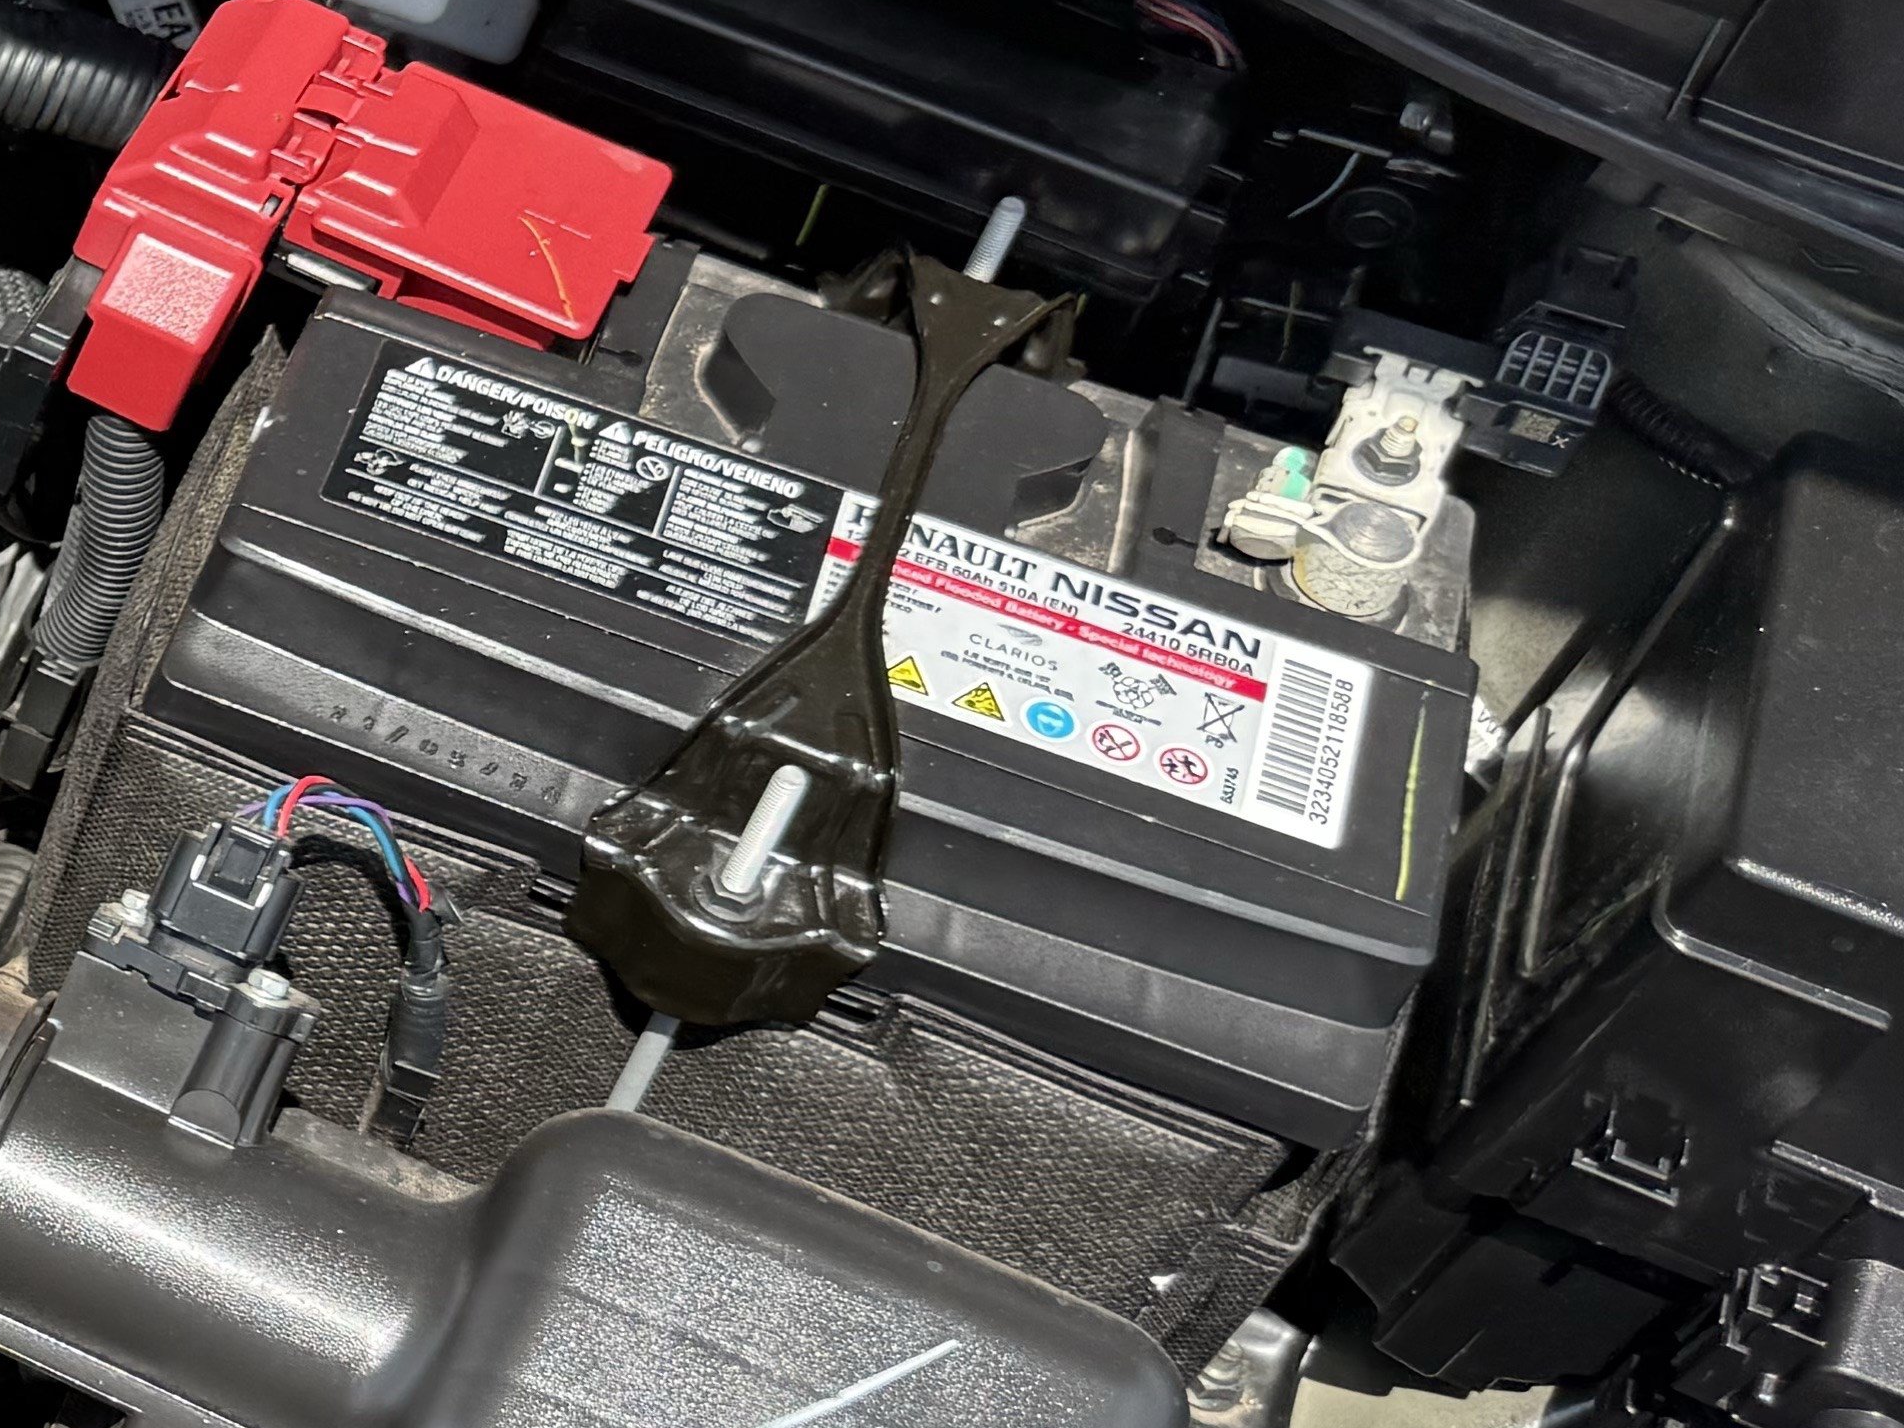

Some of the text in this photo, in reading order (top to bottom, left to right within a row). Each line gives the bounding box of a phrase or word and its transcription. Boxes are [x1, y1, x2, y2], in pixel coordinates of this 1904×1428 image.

[435, 362, 597, 432] DANGER/POISON
[631, 428, 804, 501] PELIGRO/VENENO
[847, 501, 1037, 584] RNAULT
[1049, 569, 1264, 662] NISSAN
[914, 551, 948, 572] EFB
[951, 563, 995, 589] 60Ah
[1041, 593, 1081, 620] (EN)
[933, 575, 1003, 610] Flooded
[1003, 598, 1066, 634] Battery
[1076, 623, 1140, 658] Special
[967, 631, 1061, 674] CLARIOS
[1121, 619, 1182, 652] 24410
